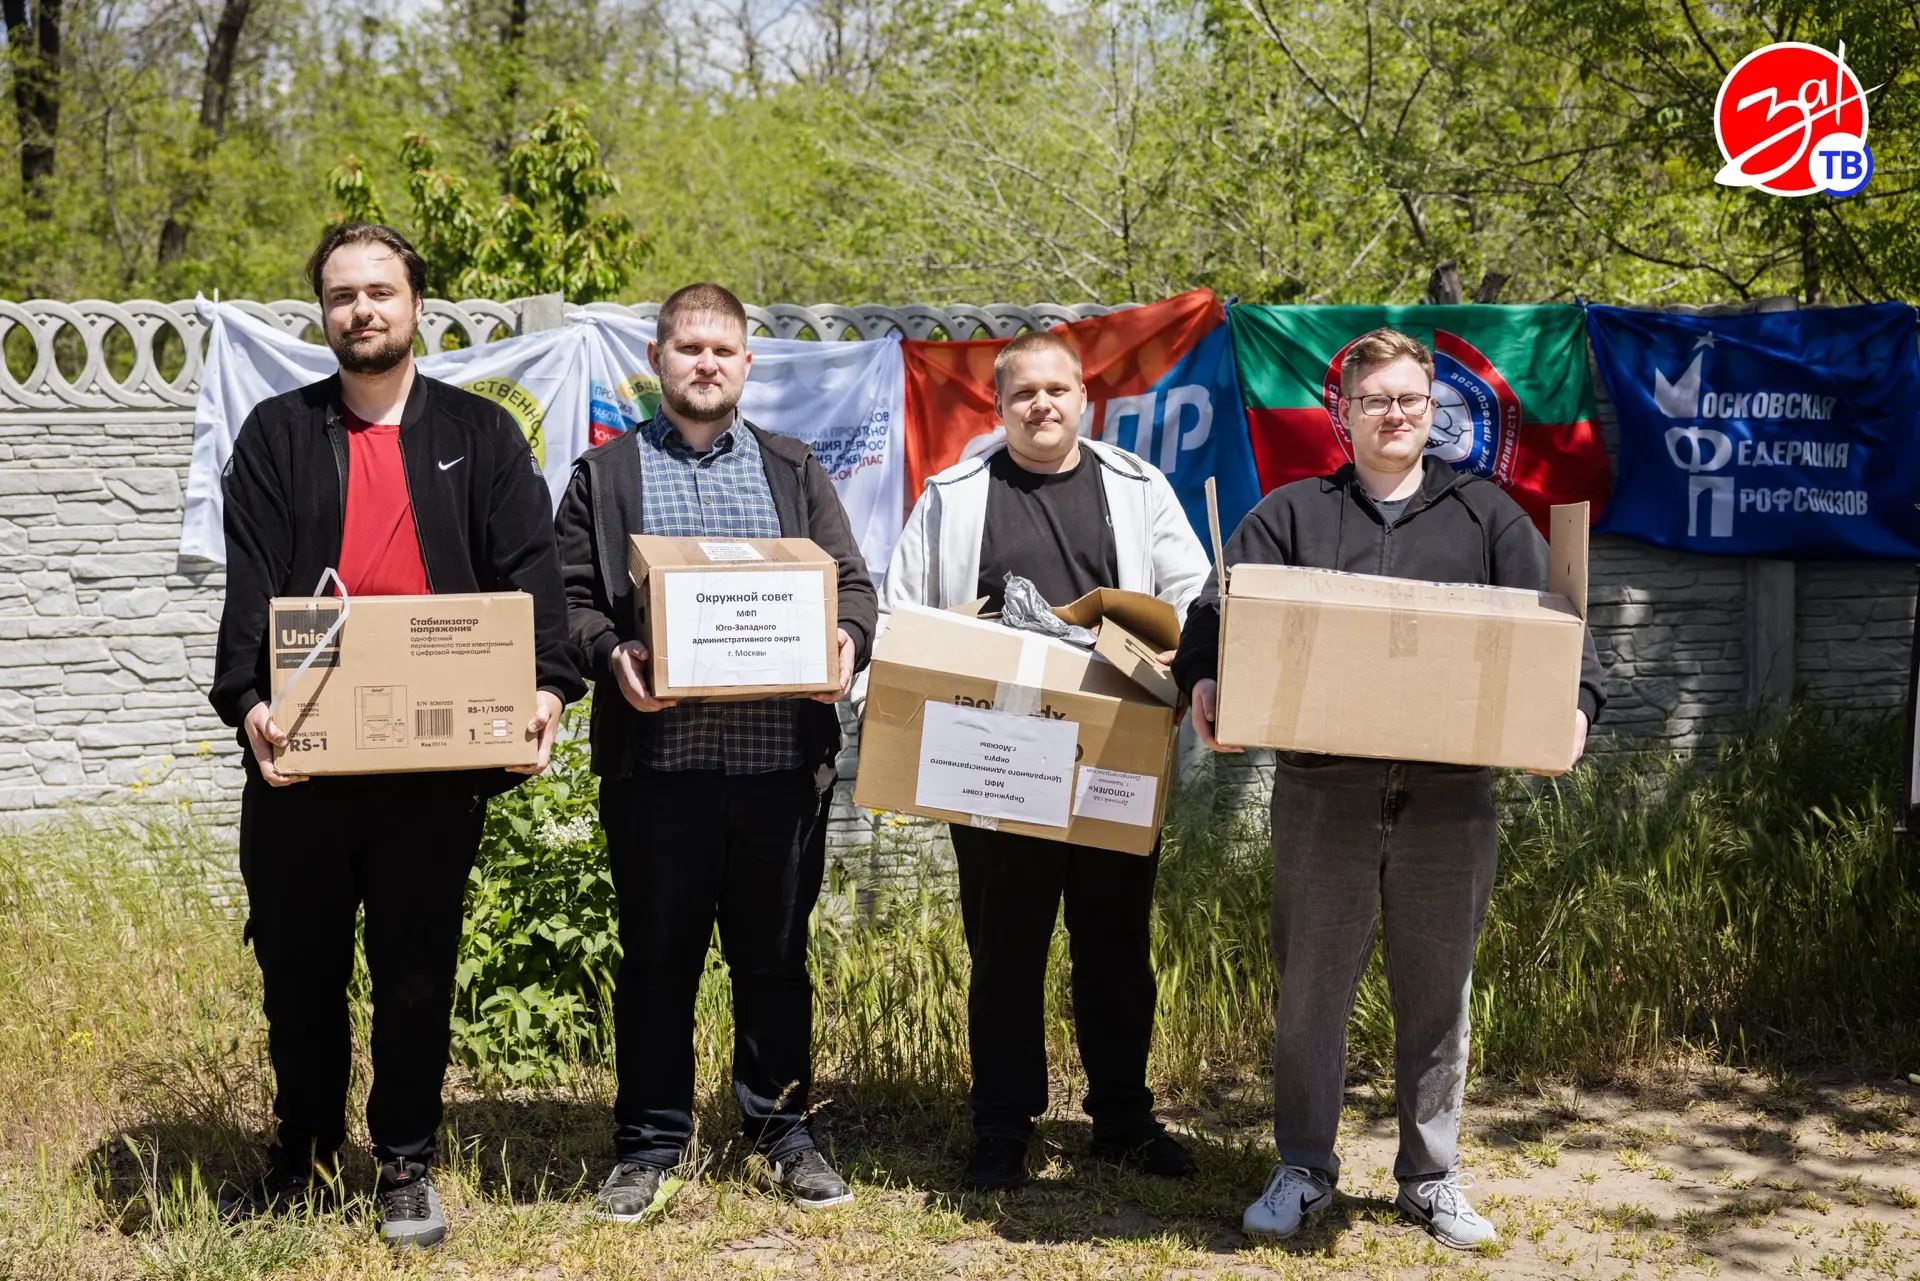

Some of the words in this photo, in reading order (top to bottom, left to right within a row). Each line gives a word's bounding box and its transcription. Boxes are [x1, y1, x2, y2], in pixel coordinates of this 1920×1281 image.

[696, 592, 758, 605] Окружной
[761, 593, 794, 602] совет
[736, 609, 757, 617] МФП
[410, 617, 479, 626] Стабилизатор
[410, 625, 472, 634] напряжения
[715, 623, 777, 633] Юго-Западного
[471, 640, 514, 648] электронный
[692, 635, 772, 645] административного
[774, 635, 801, 644] округа
[416, 648, 450, 657] цифровой
[451, 648, 491, 656] индикацией
[735, 649, 767, 657] Москвы
[468, 705, 514, 714] RS-1/15000
[469, 728, 475, 741] 1
[290, 737, 327, 752] RS-1
[979, 741, 1017, 752] г.Москвы
[984, 755, 1010, 764] округа
[930, 758, 1007, 775] административного
[1008, 769, 1062, 784] Центрального
[984, 779, 1005, 788] МФП
[962, 788, 983, 797] совет
[1088, 785, 1135, 798] «ТОПОЛЕК»
[984, 791, 1025, 803] Окружной
[1105, 797, 1128, 806] Детский
